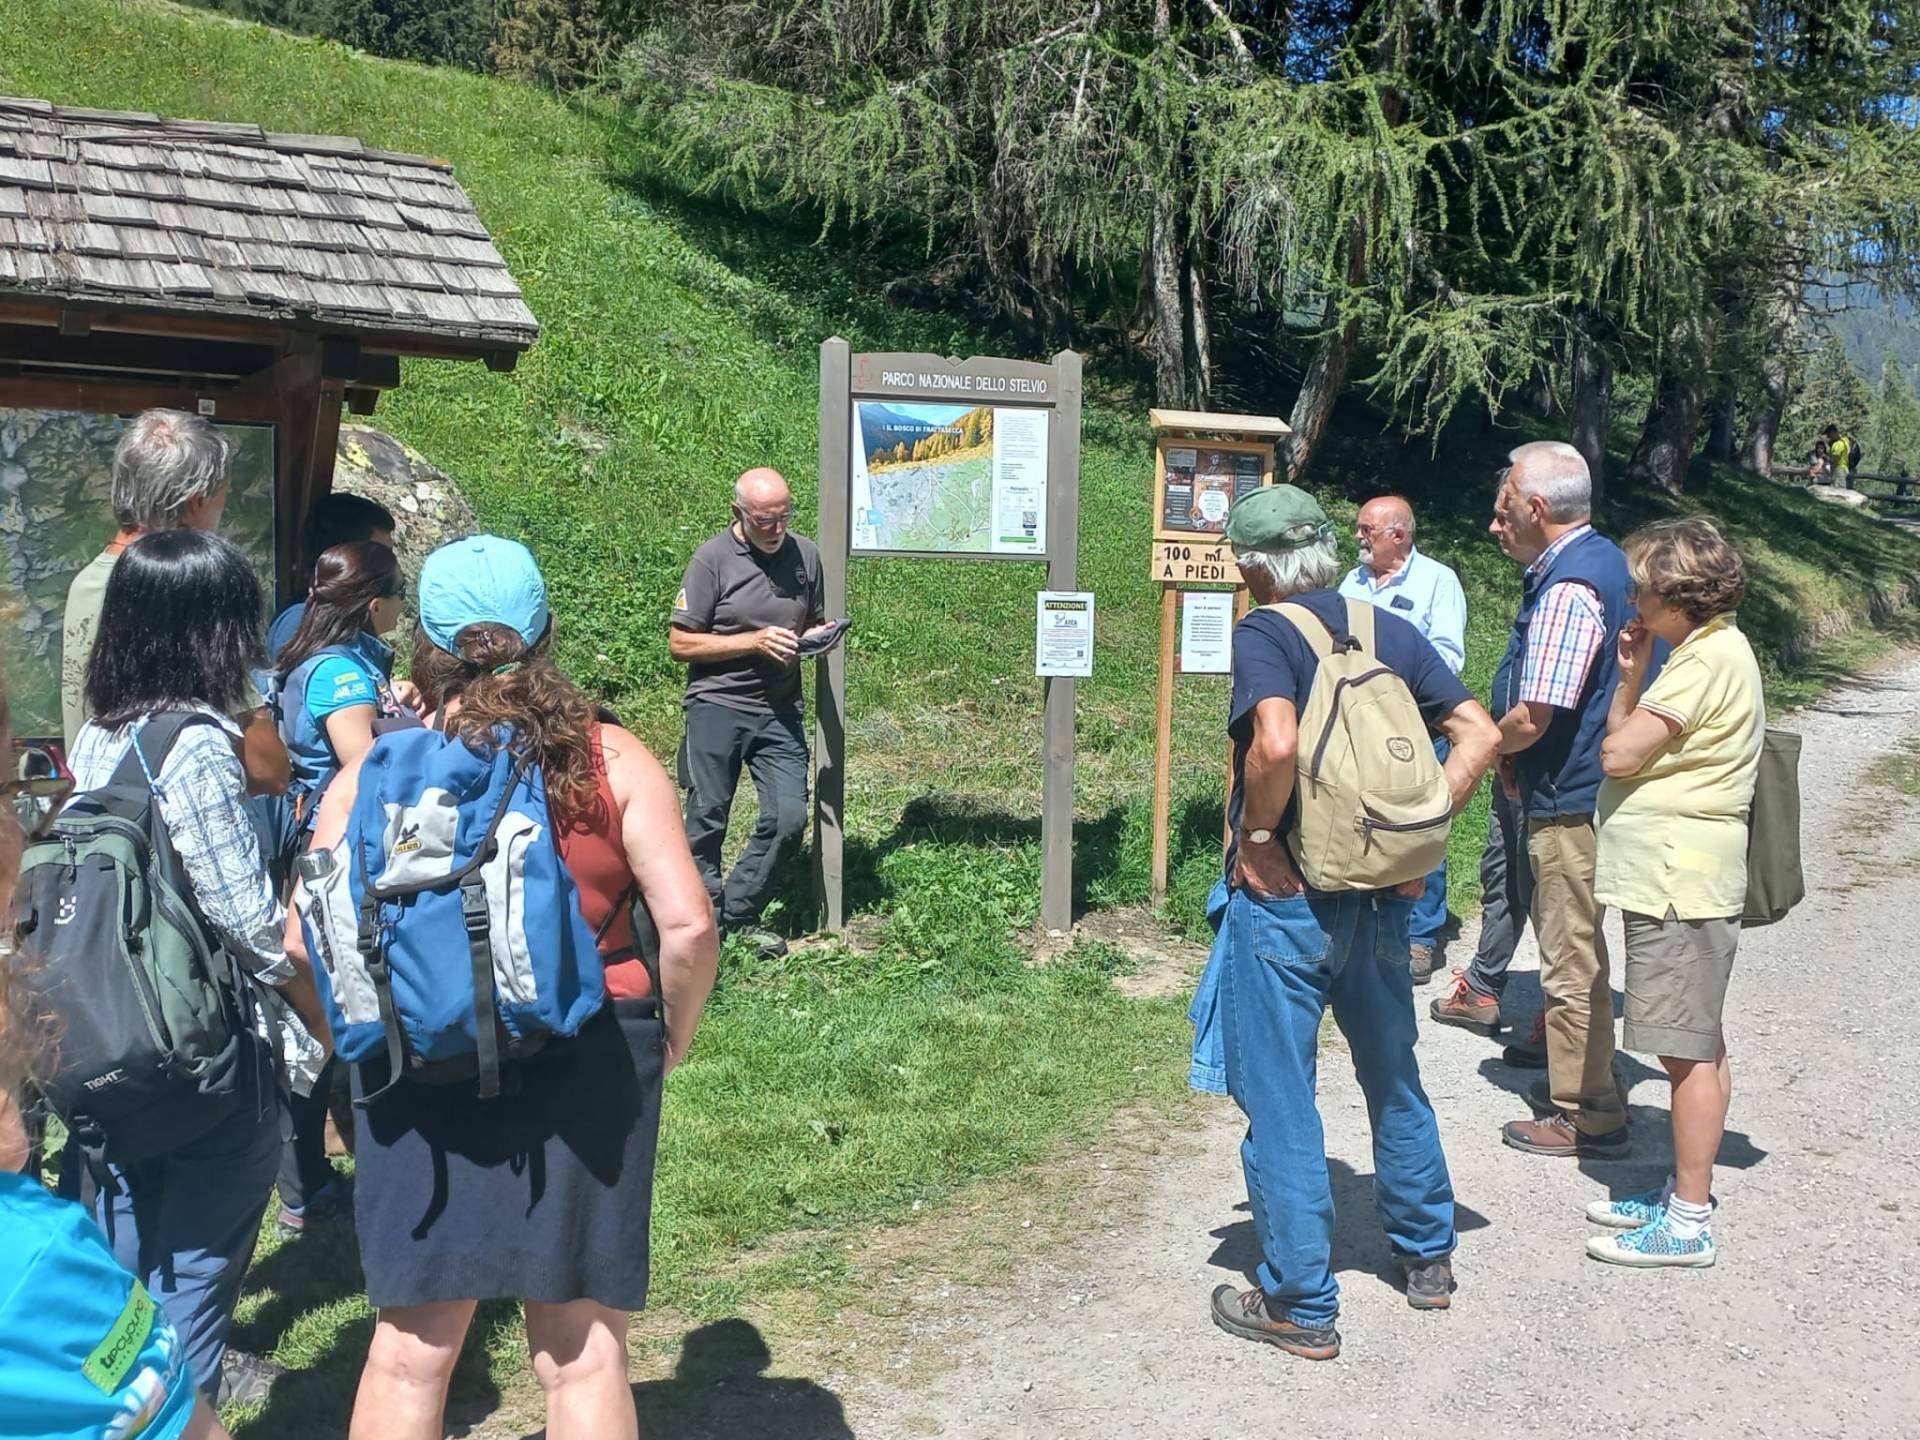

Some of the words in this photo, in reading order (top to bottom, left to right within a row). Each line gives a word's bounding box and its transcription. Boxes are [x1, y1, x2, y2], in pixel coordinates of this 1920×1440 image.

[882, 371, 914, 386] PARCO
[919, 373, 971, 390] NAZIONALE
[976, 377, 1005, 390] DELLO
[1010, 379, 1047, 393] STELVIO
[1164, 546, 1191, 560] 100
[1163, 564, 1173, 578] A
[1185, 565, 1225, 579] PIEDI
[1045, 602, 1087, 610] ATTENZIONE
[83, 1068, 122, 1090] TIGHT
